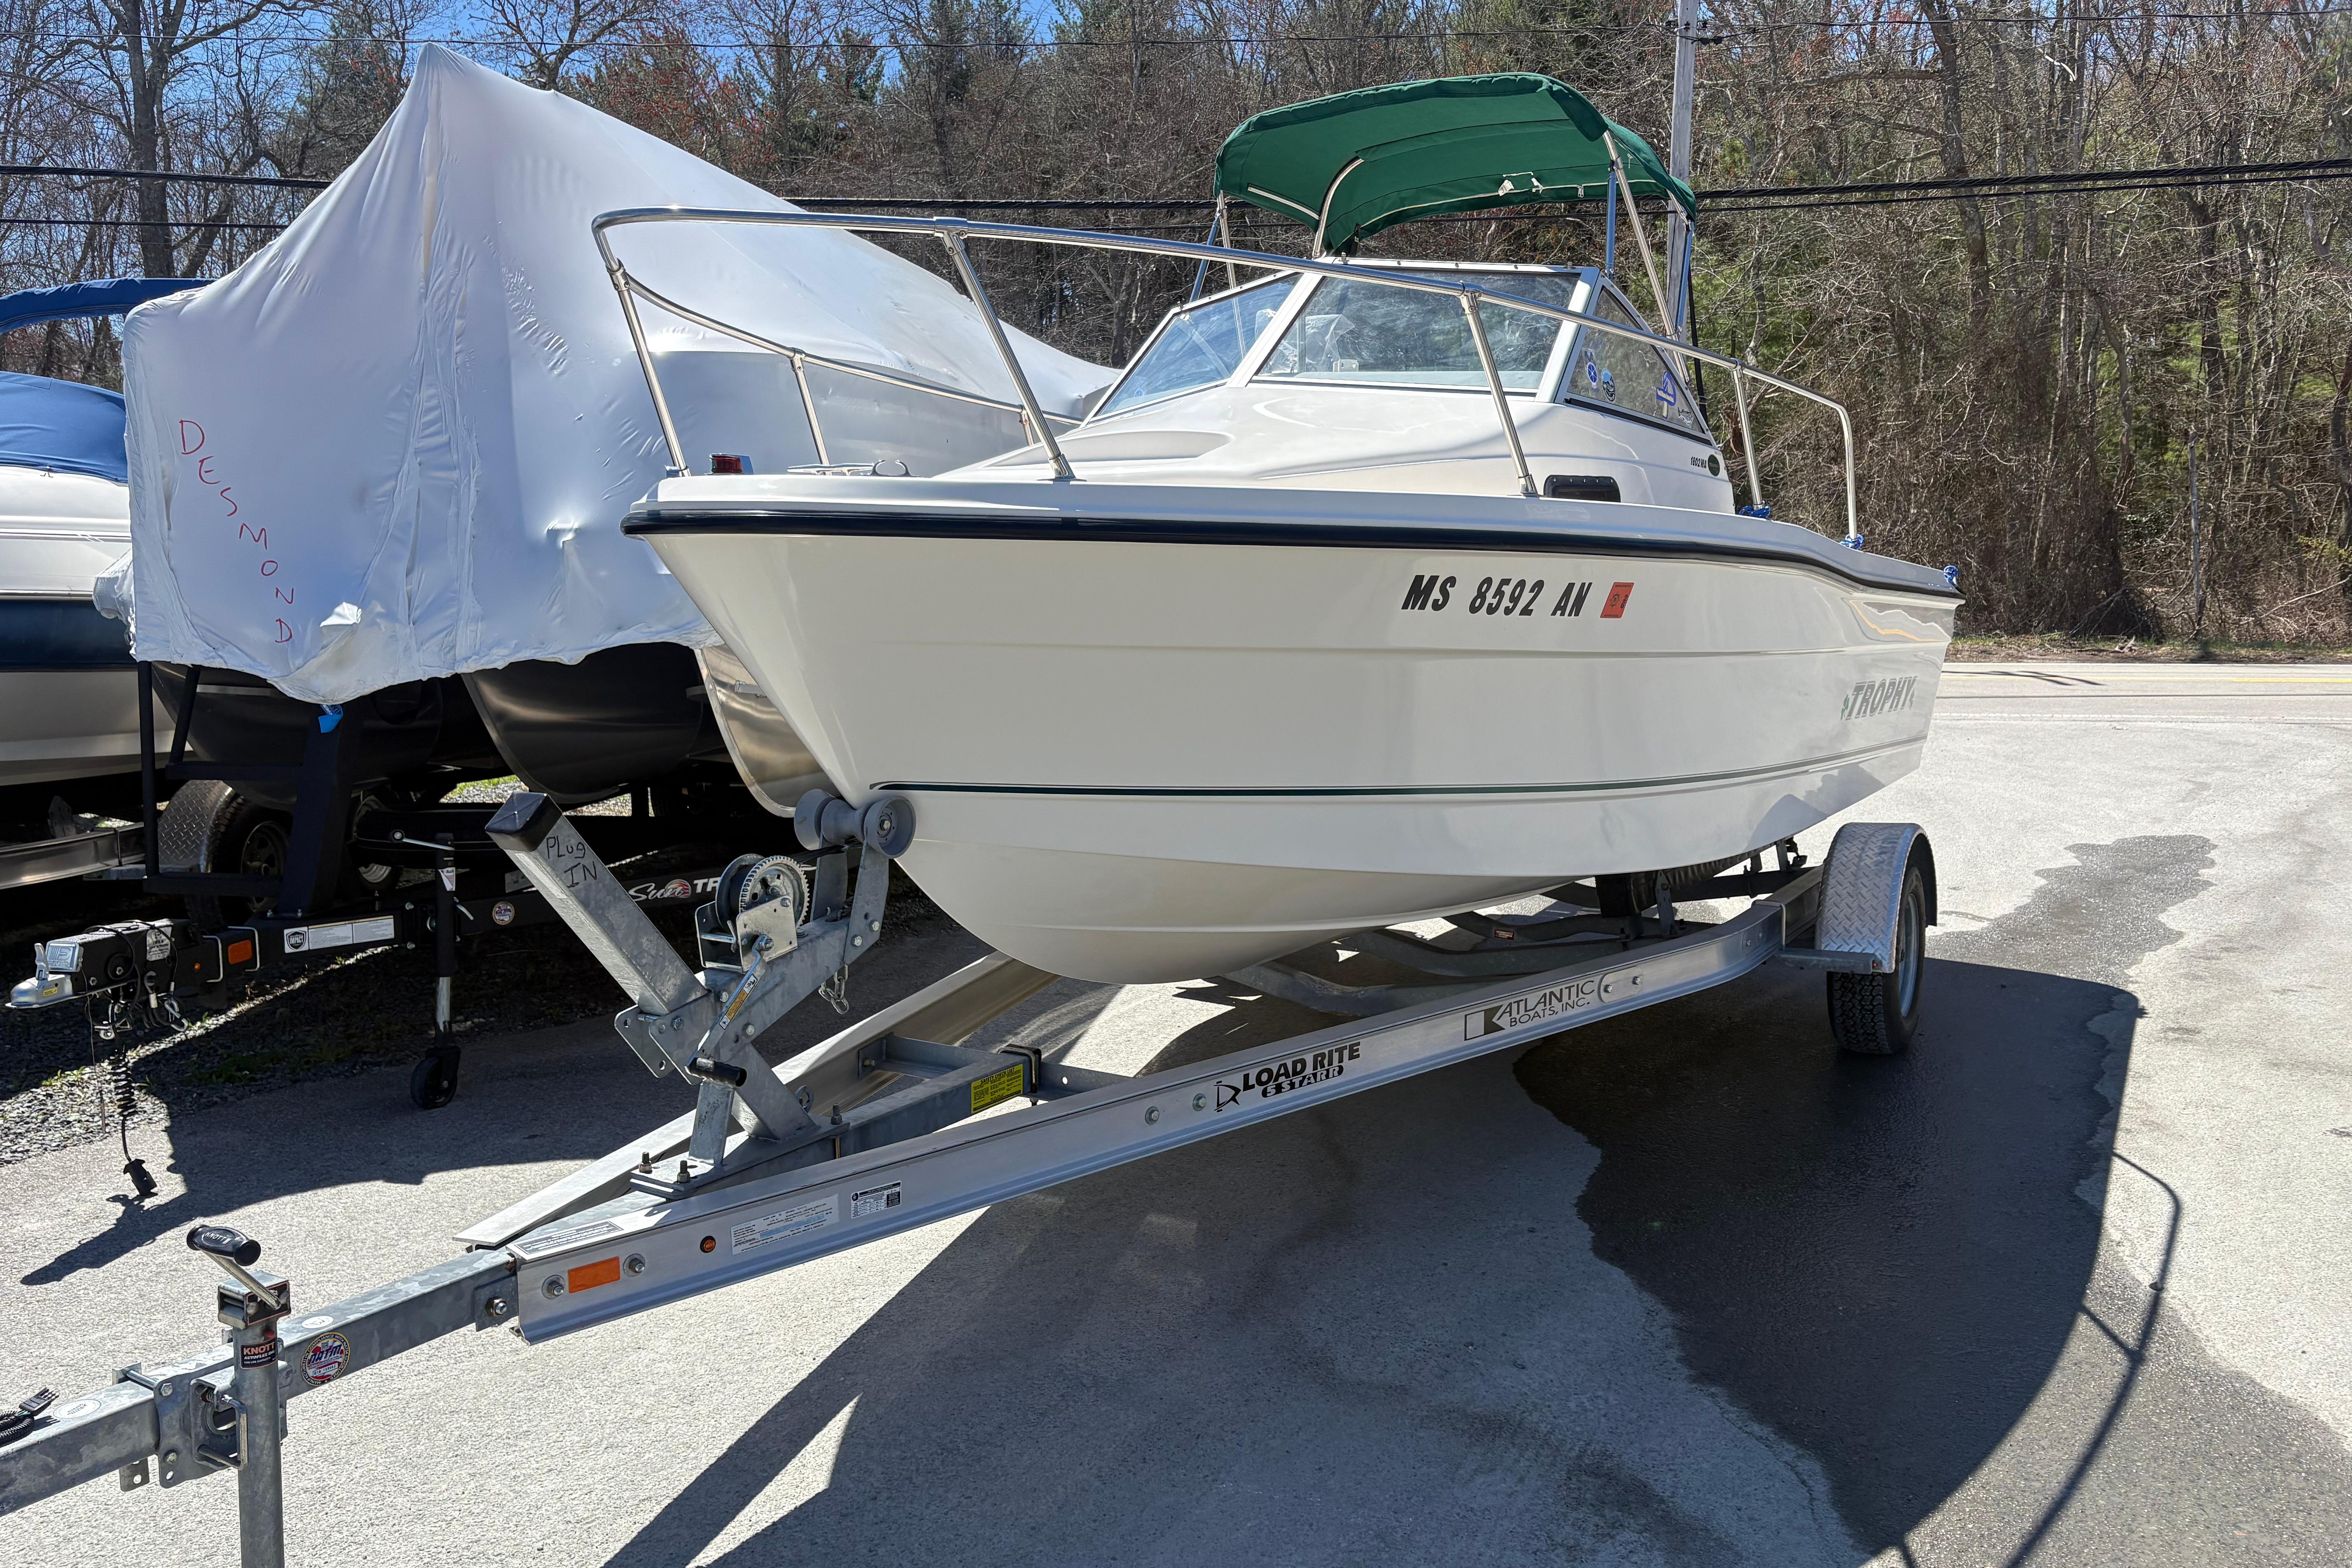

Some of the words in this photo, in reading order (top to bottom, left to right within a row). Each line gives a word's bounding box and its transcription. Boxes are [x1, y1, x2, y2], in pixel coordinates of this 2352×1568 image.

[179, 419, 294, 643] DESMOND
[1401, 574, 1457, 611] MS
[1469, 576, 1544, 616] 8592
[1550, 582, 1593, 617] AN
[1846, 676, 1918, 721] TROPHY
[563, 862, 598, 888] IN
[628, 882, 685, 902] Sun
[1496, 980, 1595, 1021] ATLANTIC
[1510, 1006, 1558, 1027] BOATS,
[1561, 998, 1591, 1012] INC.
[1243, 1058, 1307, 1092] LOAD
[1312, 1041, 1361, 1071] RITE
[1267, 1085, 1277, 1097] 5
[205, 1232, 226, 1242] KNOTT
[243, 1342, 275, 1355] KNOTT
